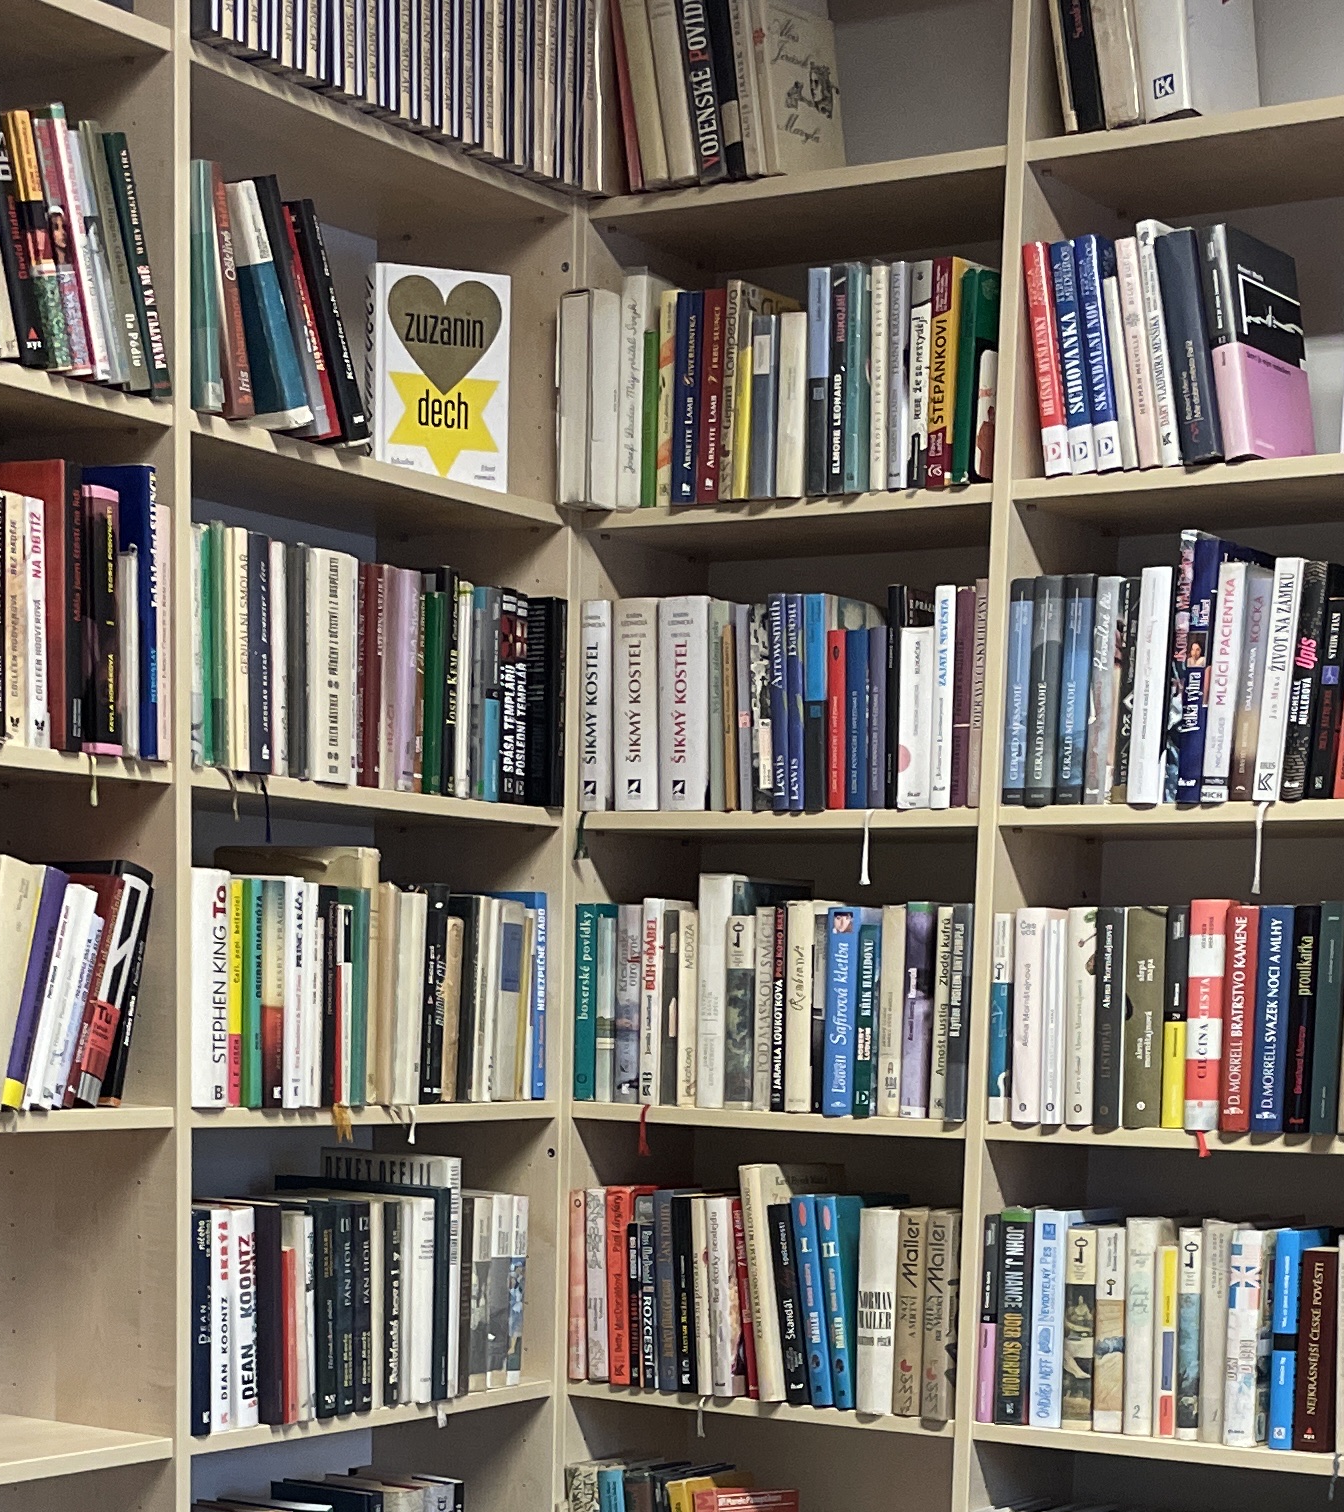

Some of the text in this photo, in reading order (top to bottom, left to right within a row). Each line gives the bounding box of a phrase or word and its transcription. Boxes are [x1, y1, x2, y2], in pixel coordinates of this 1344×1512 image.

[404, 312, 485, 349] zuzanin
[929, 318, 948, 425] ŠTĚPÁNKOVI
[1063, 312, 1085, 416] SCHOVANKA
[417, 389, 468, 429] dech
[583, 641, 599, 765] ŠIKMÝ KOSTEL
[626, 640, 642, 763] ŠIKMÝ KOSTEL
[673, 639, 688, 764] ŠIKMÝ KOSTEL
[768, 601, 786, 798] Lewis Arrowsmith
[212, 886, 227, 1064] STEPHEN KING To
[578, 911, 593, 1021] boxerské povídky
[831, 942, 850, 1095] Lowell Safírová kletba
[1229, 917, 1248, 1107] D. MORRELL BRATRSTVO KAMENE
[1261, 918, 1283, 1109] D. MORRELL SVAZEK NOCI A MLHY
[239, 1236, 257, 1400] DEAN KOONTZ
